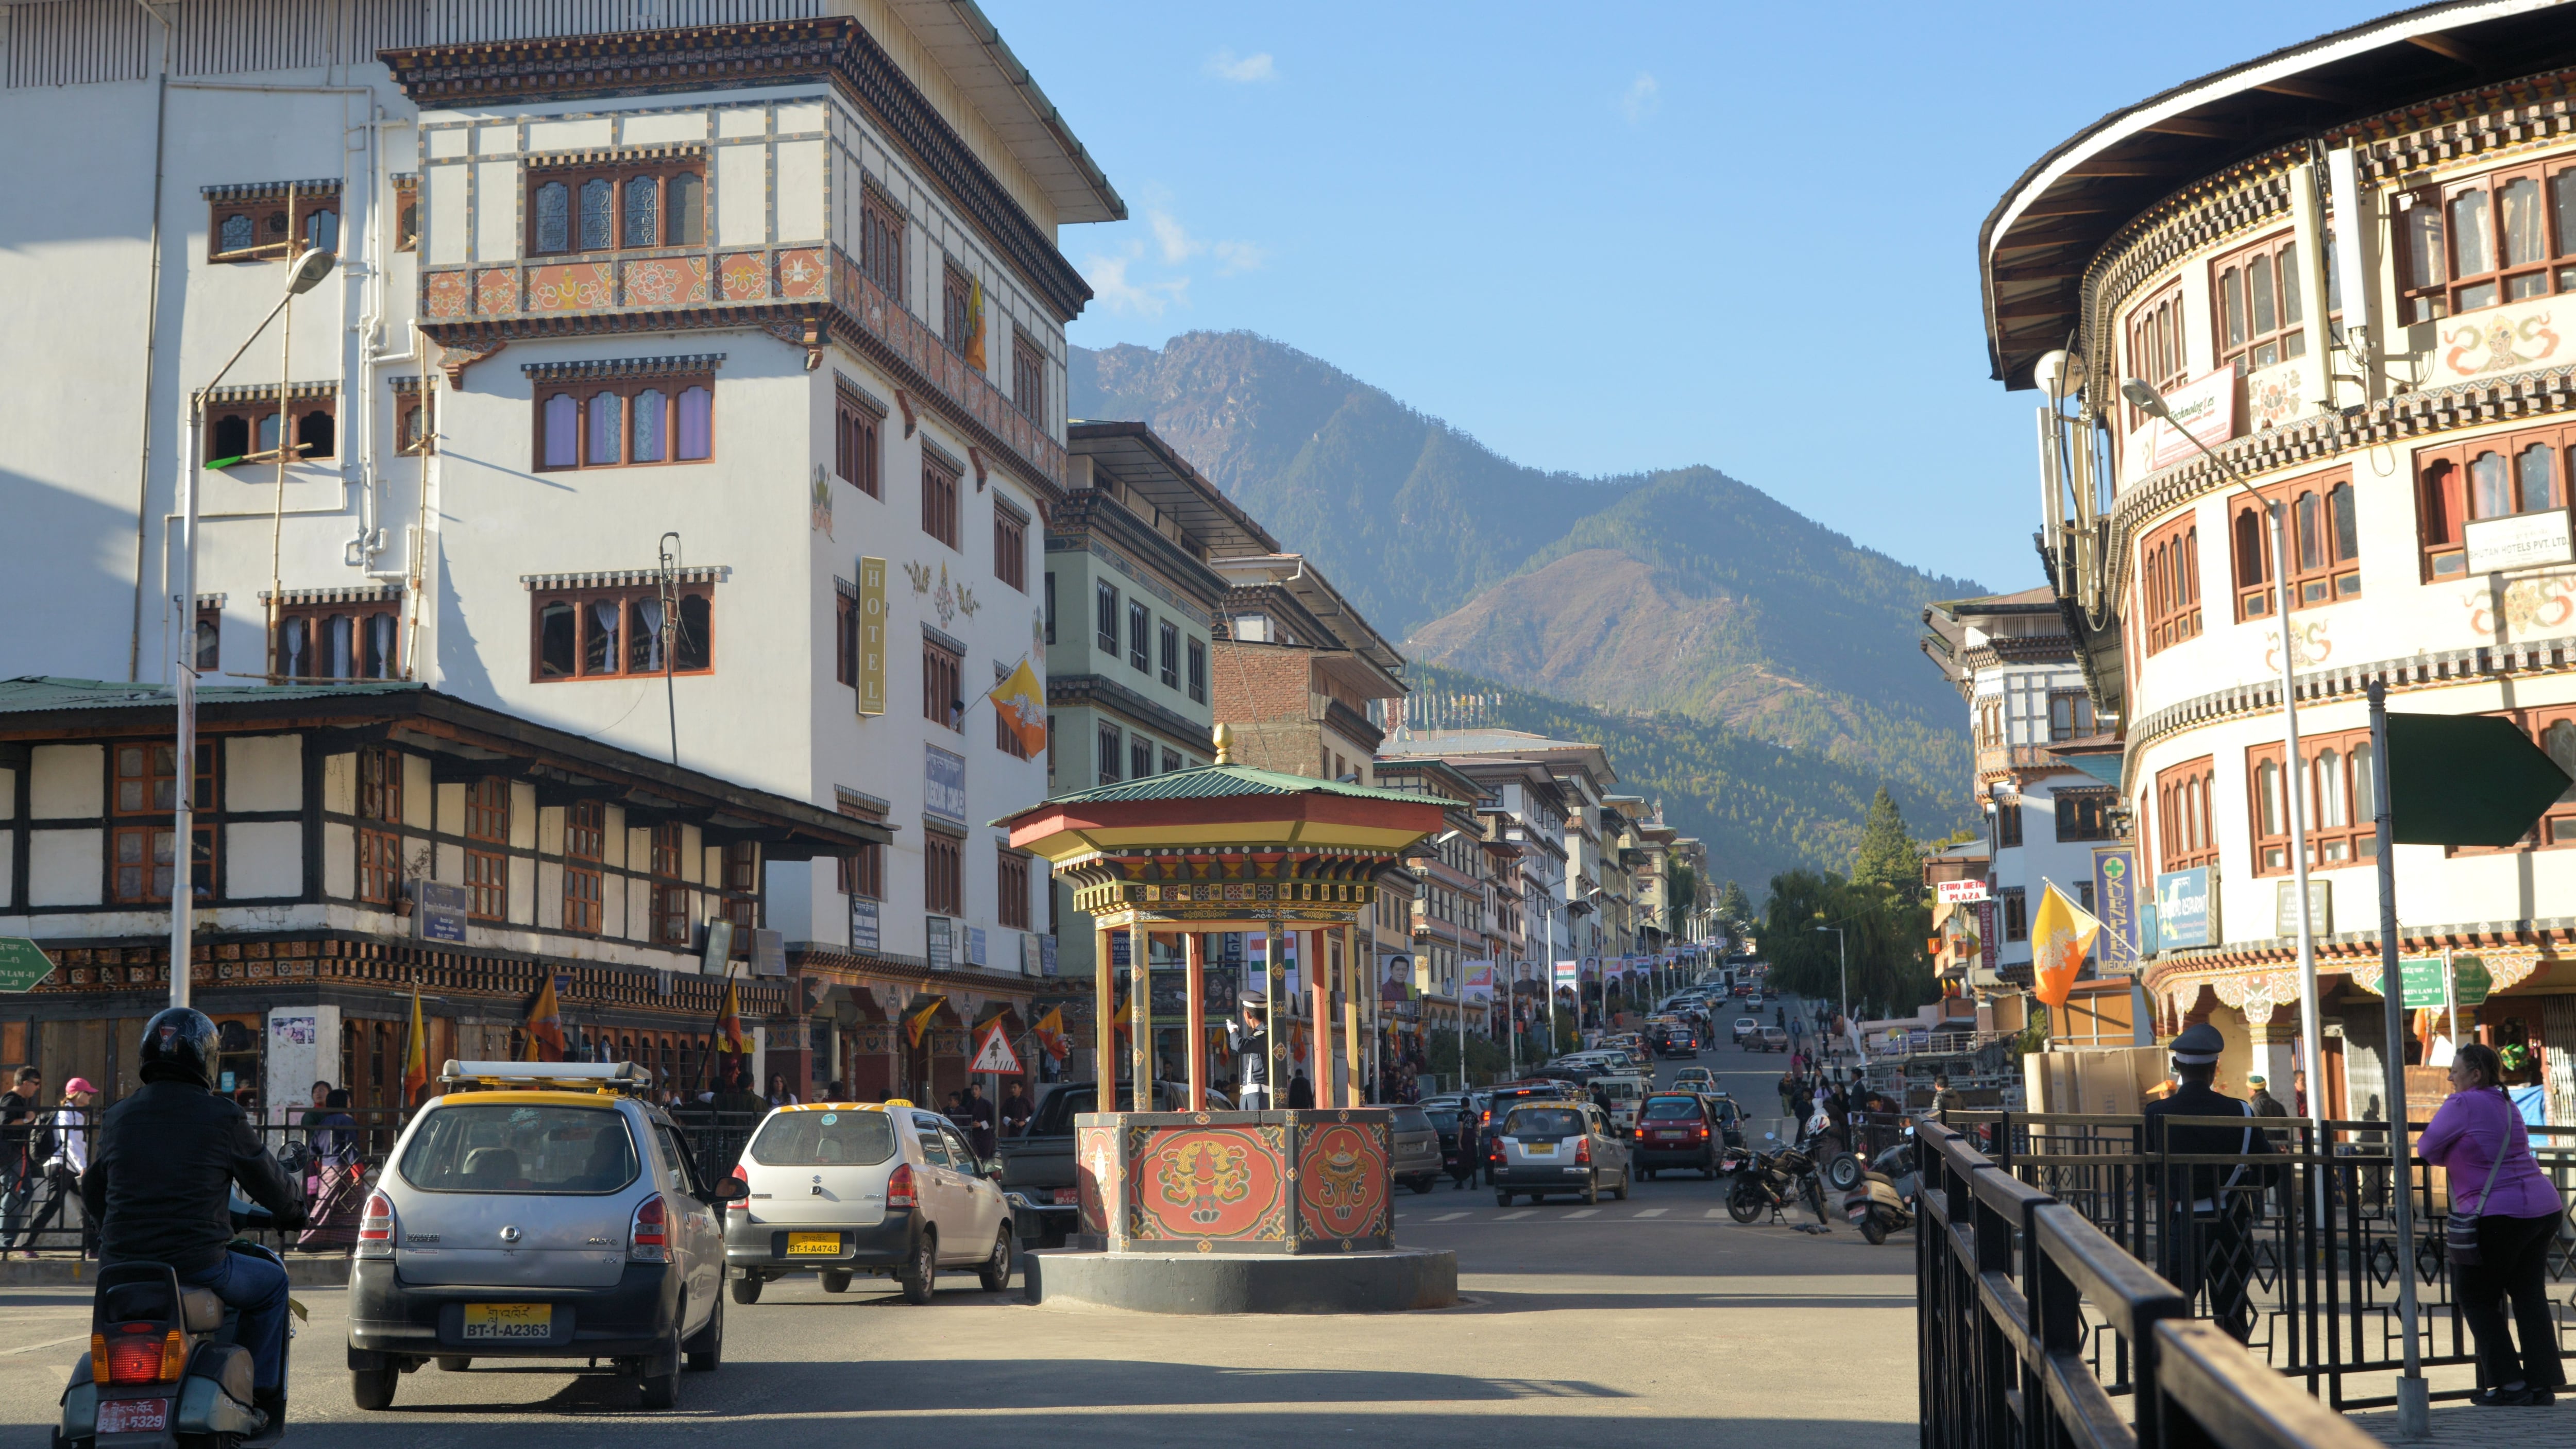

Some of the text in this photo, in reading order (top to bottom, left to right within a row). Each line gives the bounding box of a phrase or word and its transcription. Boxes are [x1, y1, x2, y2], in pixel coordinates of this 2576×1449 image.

[2501, 542, 2531, 554] HOTELS
[2533, 539, 2550, 550] PVT.
[2552, 536, 2569, 547] LTD.
[867, 569, 880, 698] HOTEL
[1950, 892, 1980, 901] PLAZA
[2106, 878, 2129, 961] KUENPHEN
[789, 1245, 838, 1253] BT-1-A4743
[467, 1324, 549, 1336] BT-1-A2363
